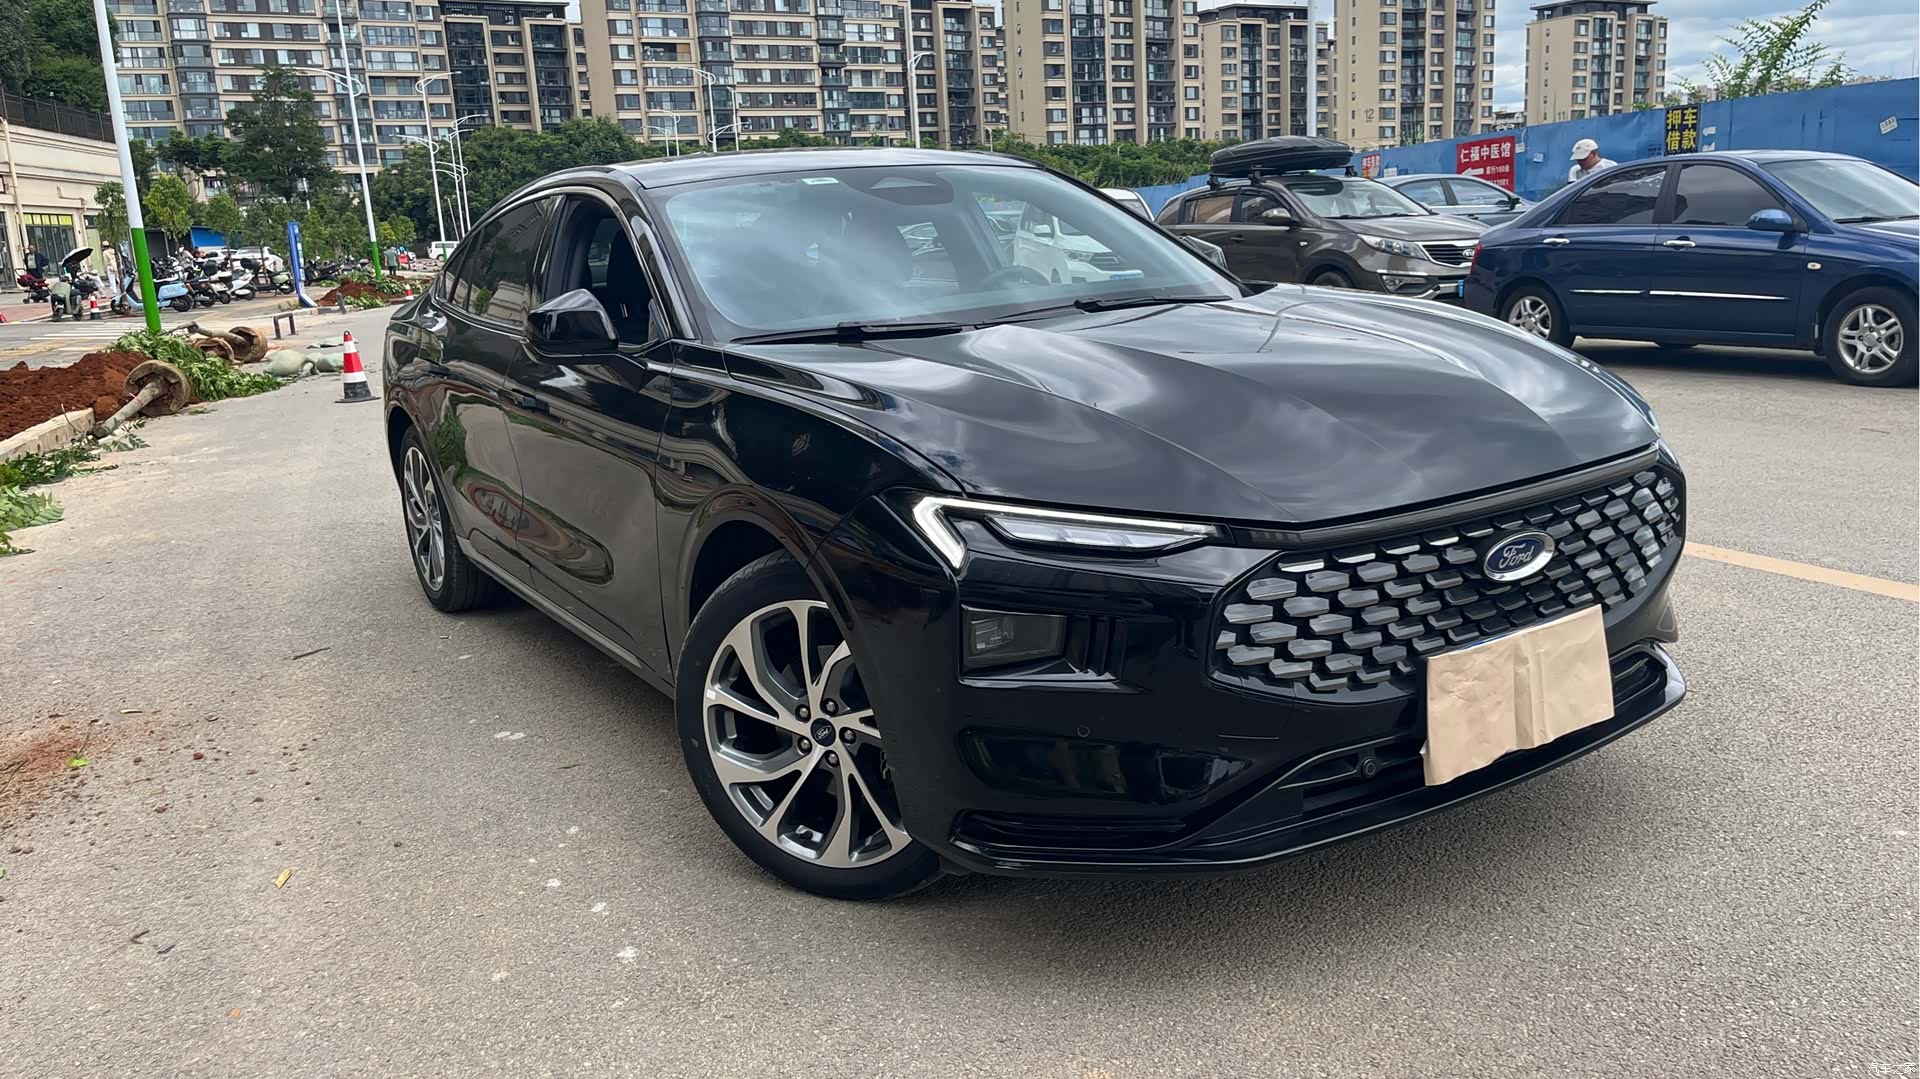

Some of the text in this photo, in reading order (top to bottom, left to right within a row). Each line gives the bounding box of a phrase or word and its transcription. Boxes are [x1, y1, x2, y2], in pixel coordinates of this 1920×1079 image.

[1364, 108, 1374, 119] 12
[1667, 108, 1698, 130] 押车
[1667, 129, 1696, 151] 借款
[1460, 141, 1512, 164] 仁福中医馆
[1499, 543, 1534, 568] Ford
